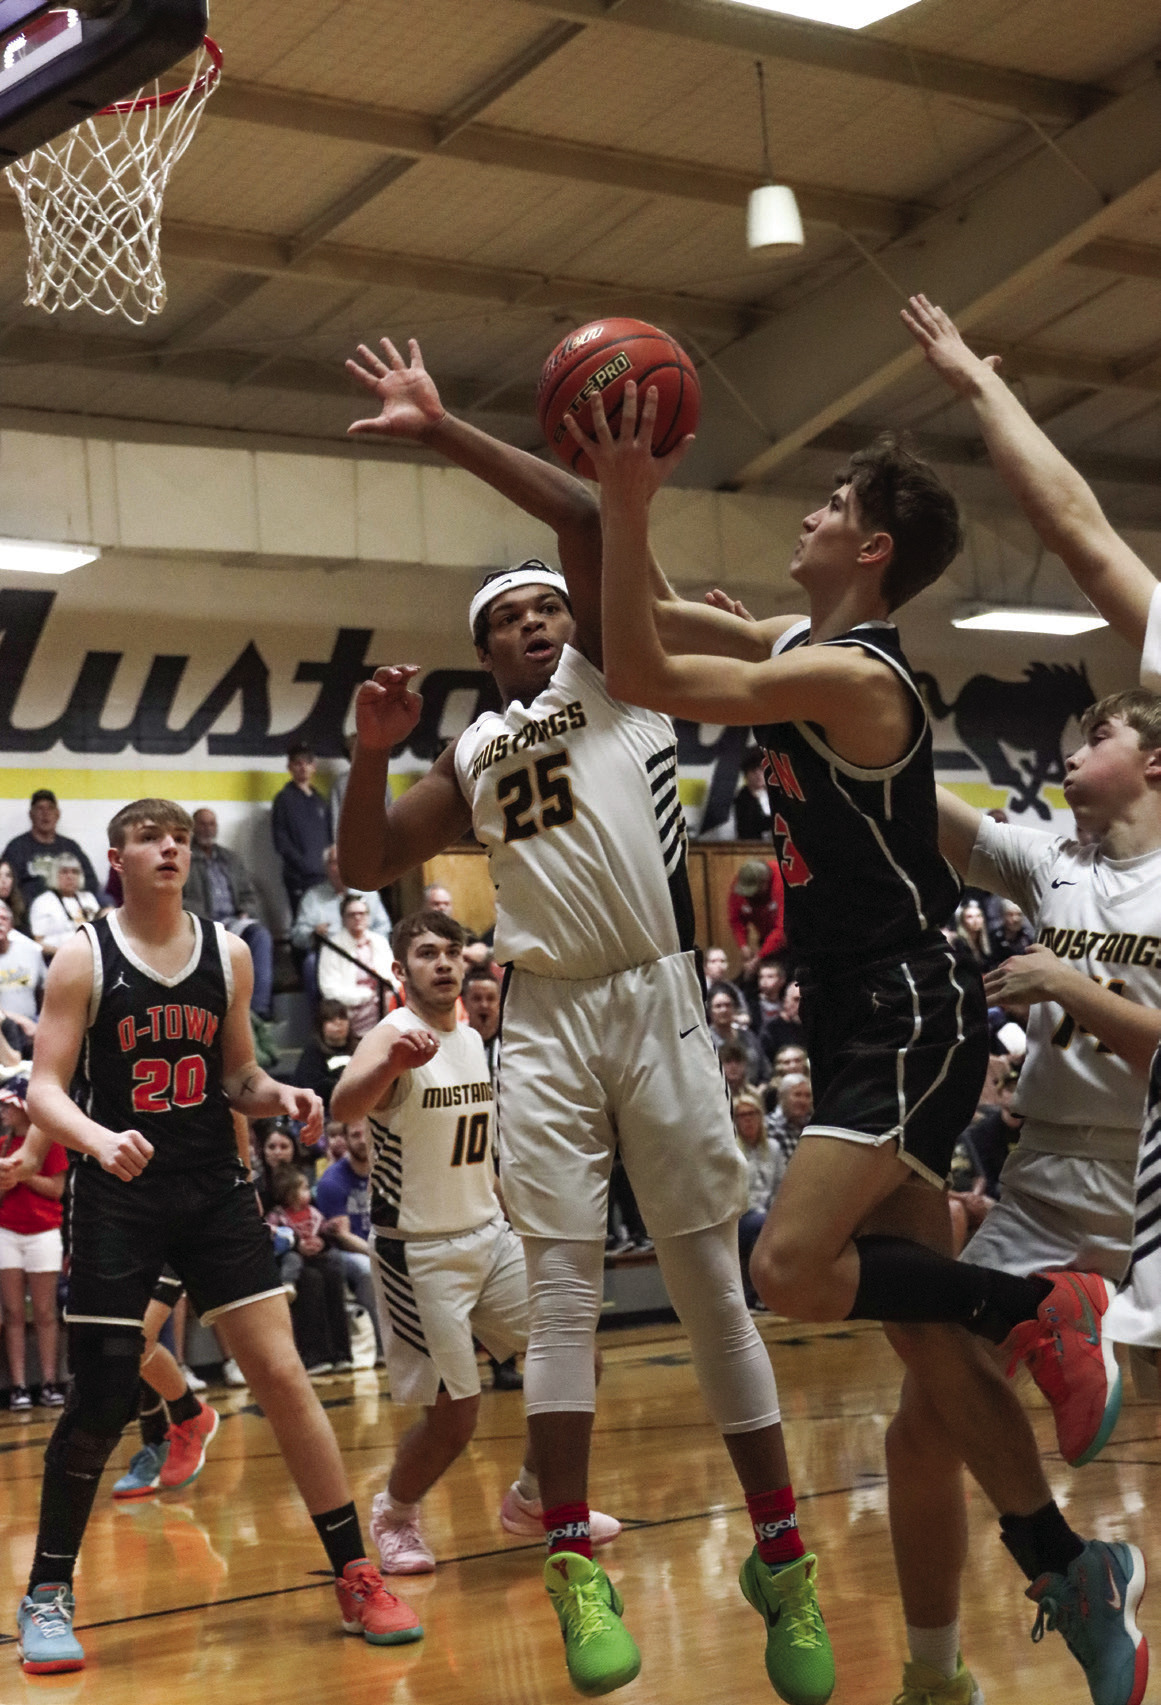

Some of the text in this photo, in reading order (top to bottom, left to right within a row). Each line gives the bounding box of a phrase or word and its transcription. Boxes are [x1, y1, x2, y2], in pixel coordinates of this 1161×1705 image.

[595, 353, 631, 388] PRO
[472, 699, 588, 781] MUSTANGS
[496, 749, 578, 845] 25
[117, 1004, 219, 1052] O-TOWN
[132, 1054, 207, 1113] 20
[450, 1111, 489, 1168] 10
